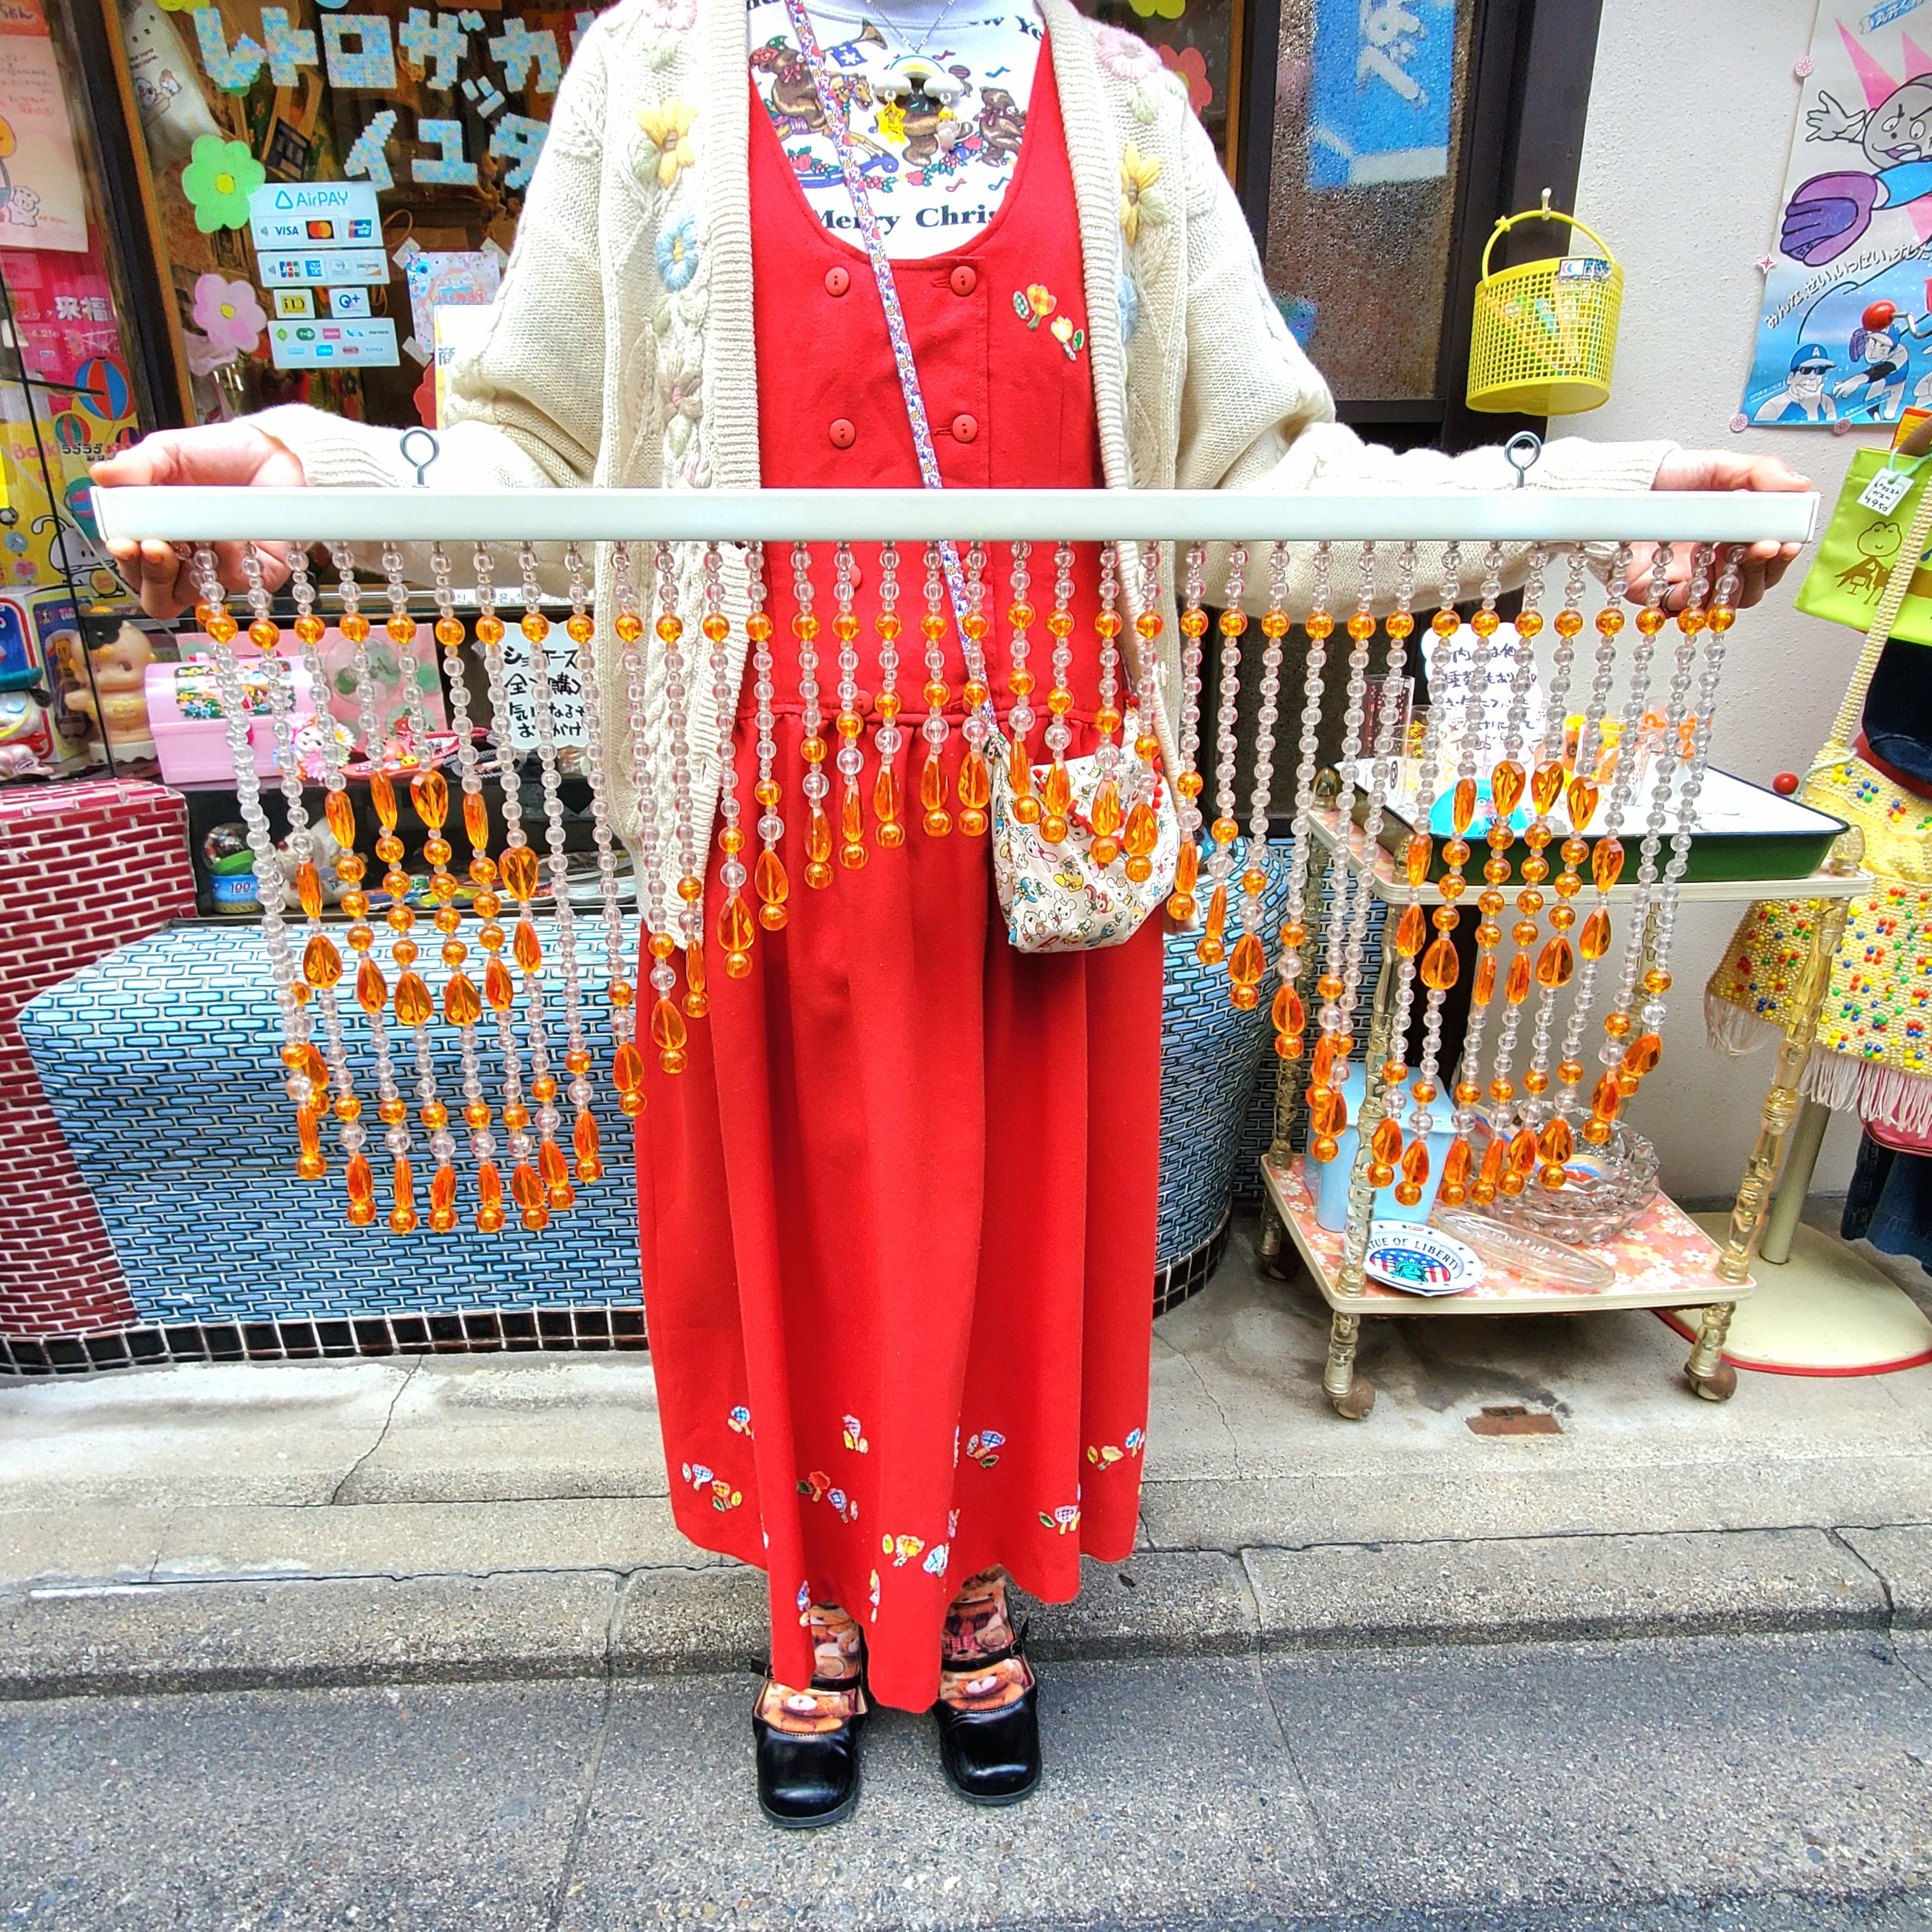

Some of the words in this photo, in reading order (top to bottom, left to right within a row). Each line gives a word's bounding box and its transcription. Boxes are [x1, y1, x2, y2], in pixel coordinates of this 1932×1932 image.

[296, 191, 348, 207] AirPAY
[274, 226, 299, 235] VISA
[1393, 1237, 1409, 1246] OF
[1414, 1240, 1460, 1270] LIBERTY
